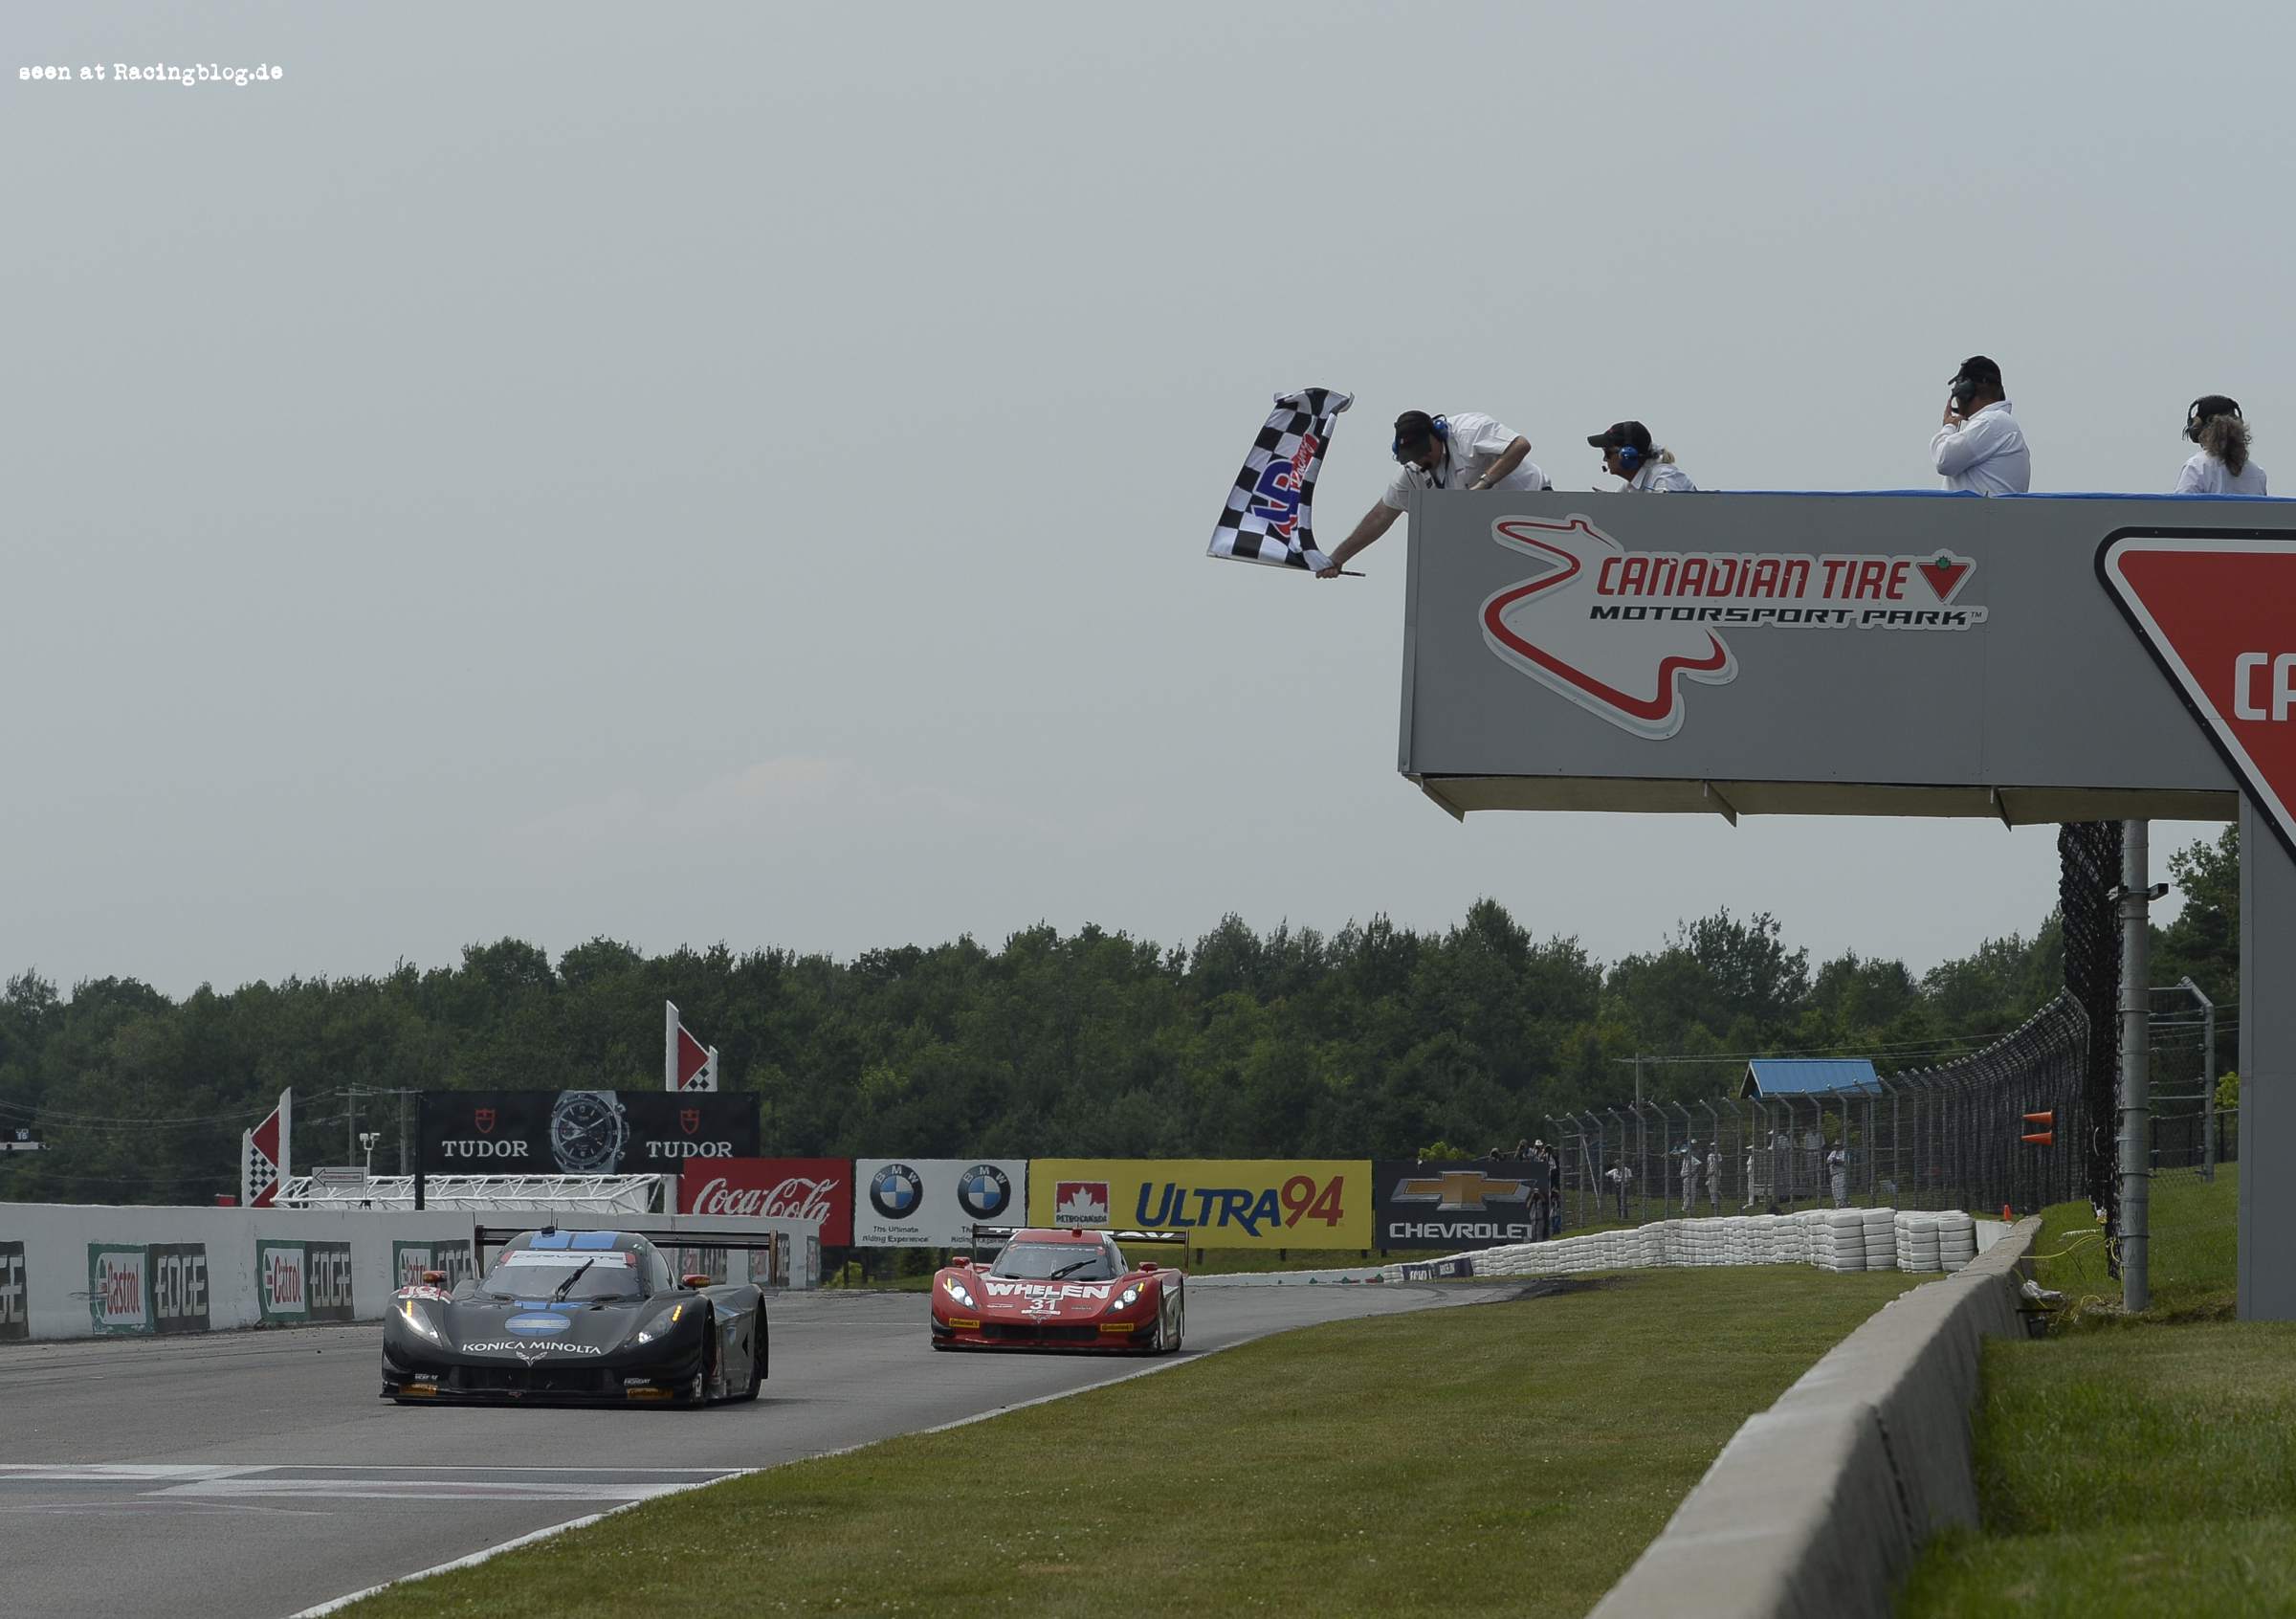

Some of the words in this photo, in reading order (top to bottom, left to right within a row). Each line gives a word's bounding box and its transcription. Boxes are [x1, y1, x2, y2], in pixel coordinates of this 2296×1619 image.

[1597, 557, 1810, 598] CANADIAN
[1822, 560, 1910, 600] TIRE
[1590, 606, 1854, 624] MOTORSPORT
[1861, 609, 1968, 626] PARK
[442, 1141, 529, 1158] TUDOR
[646, 1142, 733, 1158] TUDOR
[875, 1164, 919, 1184] BMW
[962, 1166, 1007, 1184] BMW
[691, 1177, 838, 1222] Coca-Cola
[888, 1235, 929, 1244] Experience
[107, 1261, 140, 1316] Castrol
[155, 1254, 208, 1319] EDGE
[985, 1283, 1111, 1299] WHELEN
[1029, 1299, 1057, 1310] 31
[462, 1341, 525, 1352] KONICA
[529, 1342, 602, 1355] MINOLTA
